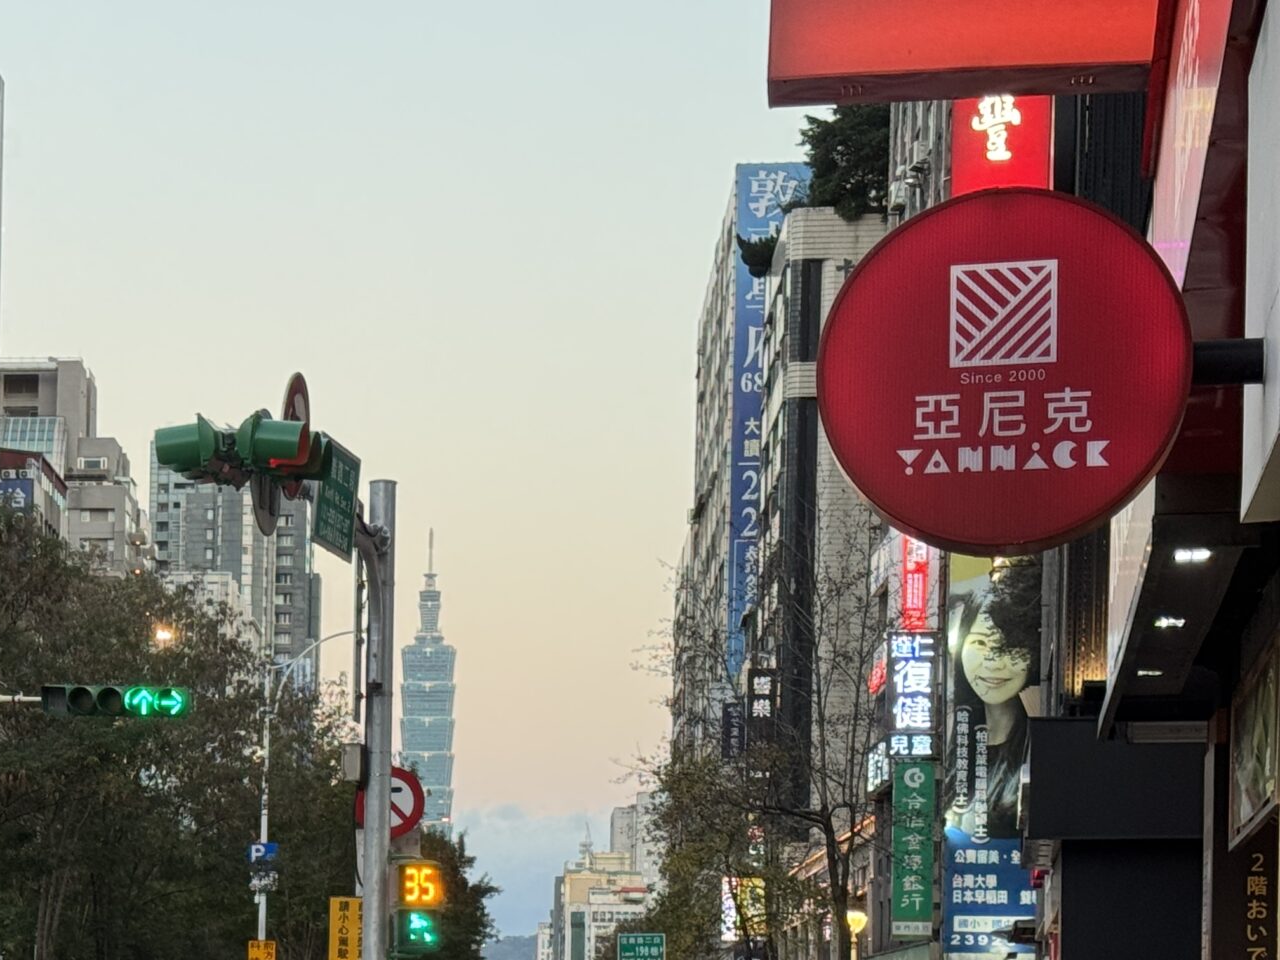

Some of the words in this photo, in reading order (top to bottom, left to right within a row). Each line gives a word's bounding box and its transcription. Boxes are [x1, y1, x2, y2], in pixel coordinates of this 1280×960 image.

[960, 371, 1003, 385] Since
[1008, 368, 1046, 382] 2000
[913, 386, 1093, 441] 亞尼克
[404, 865, 436, 902] 35
